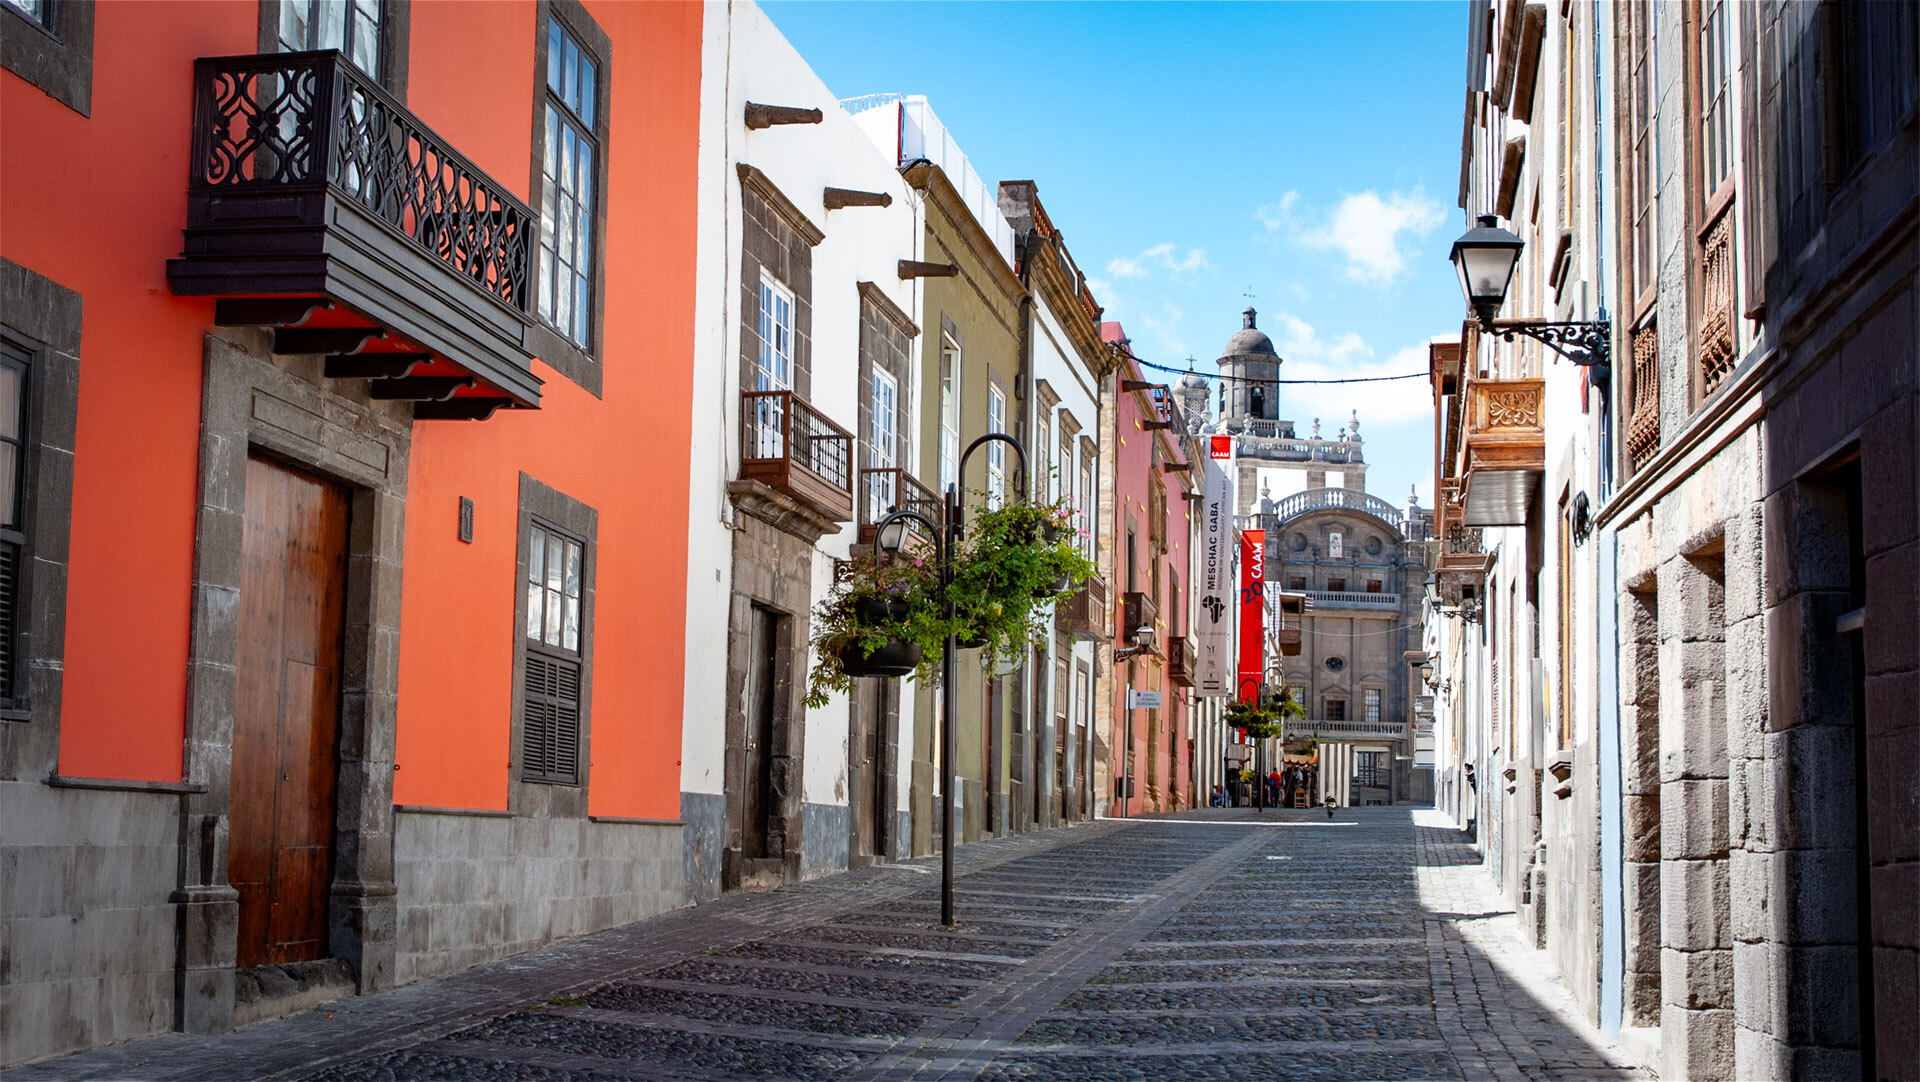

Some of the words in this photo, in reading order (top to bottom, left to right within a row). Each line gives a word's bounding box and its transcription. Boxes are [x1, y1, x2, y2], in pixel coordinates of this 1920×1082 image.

[1209, 502, 1219, 532] GABA
[1207, 537, 1218, 590] MESCHAC
[1251, 542, 1263, 579] CAAM
[1241, 581, 1263, 604] 20
